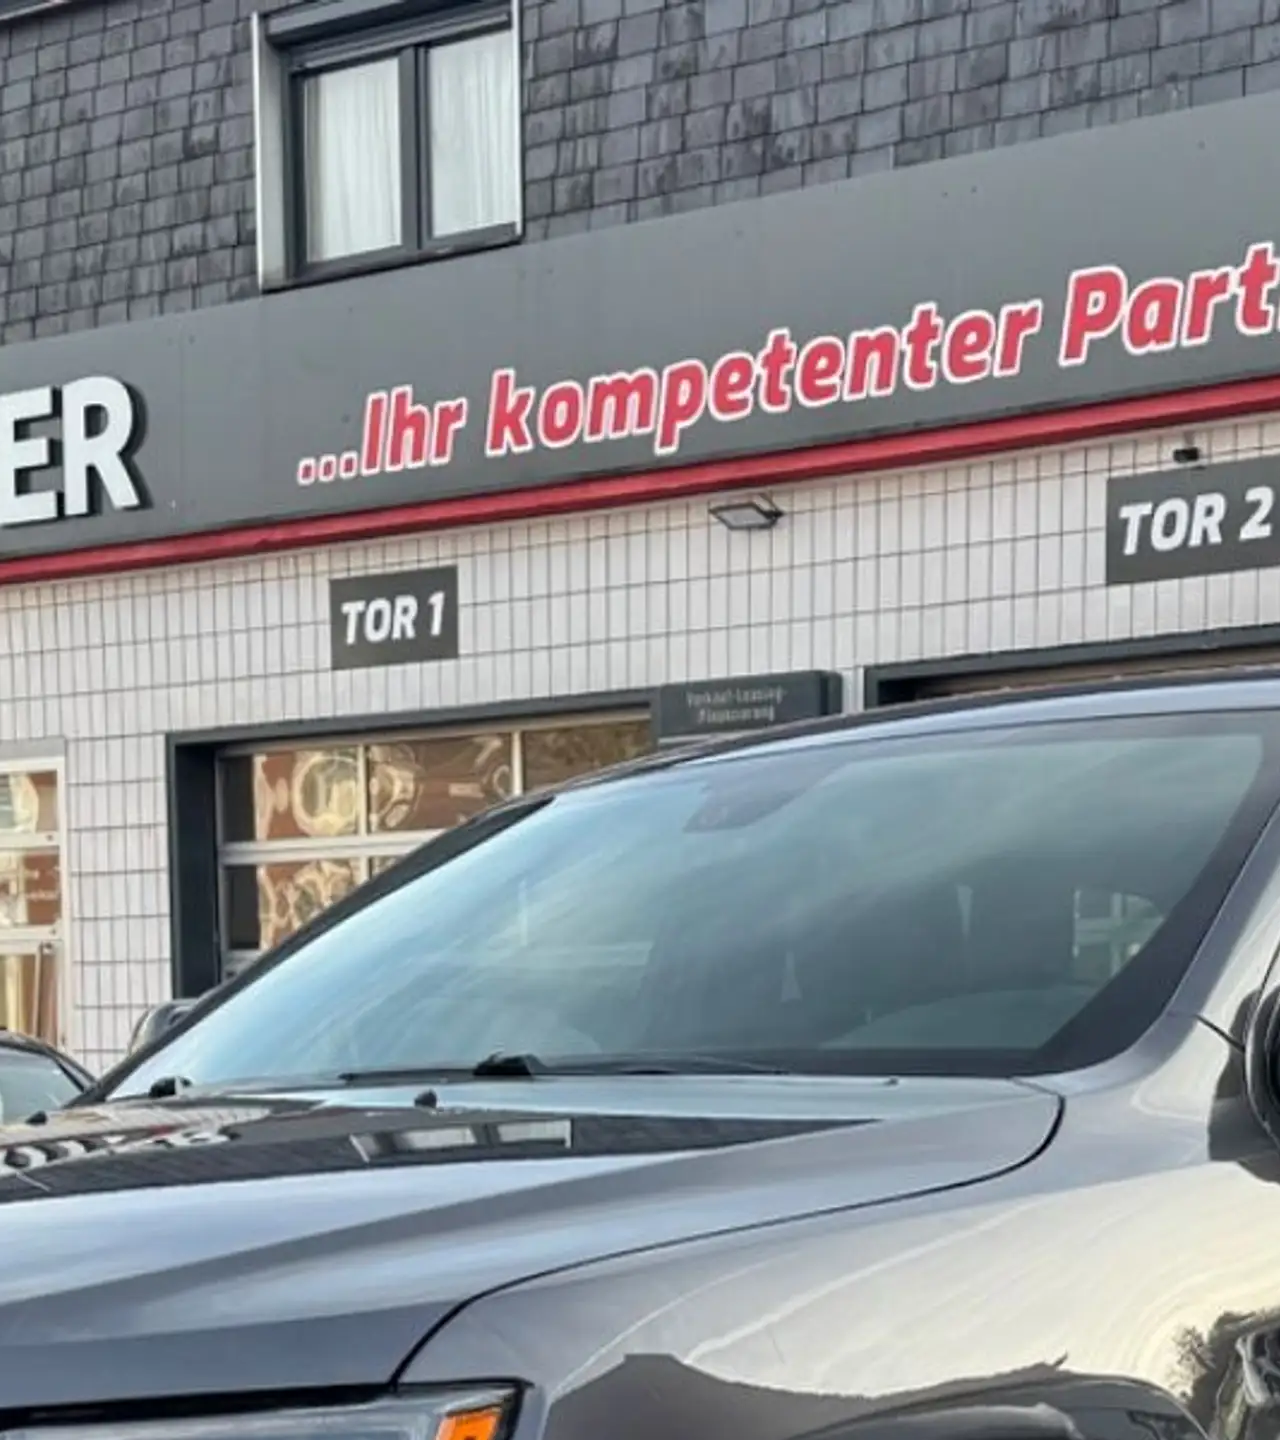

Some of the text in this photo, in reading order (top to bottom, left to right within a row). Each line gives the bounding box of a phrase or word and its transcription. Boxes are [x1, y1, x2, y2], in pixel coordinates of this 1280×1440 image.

[485, 300, 1042, 456] kompetenter
[1119, 486, 1275, 555] TOR 2
[341, 591, 445, 645] TOR 1
